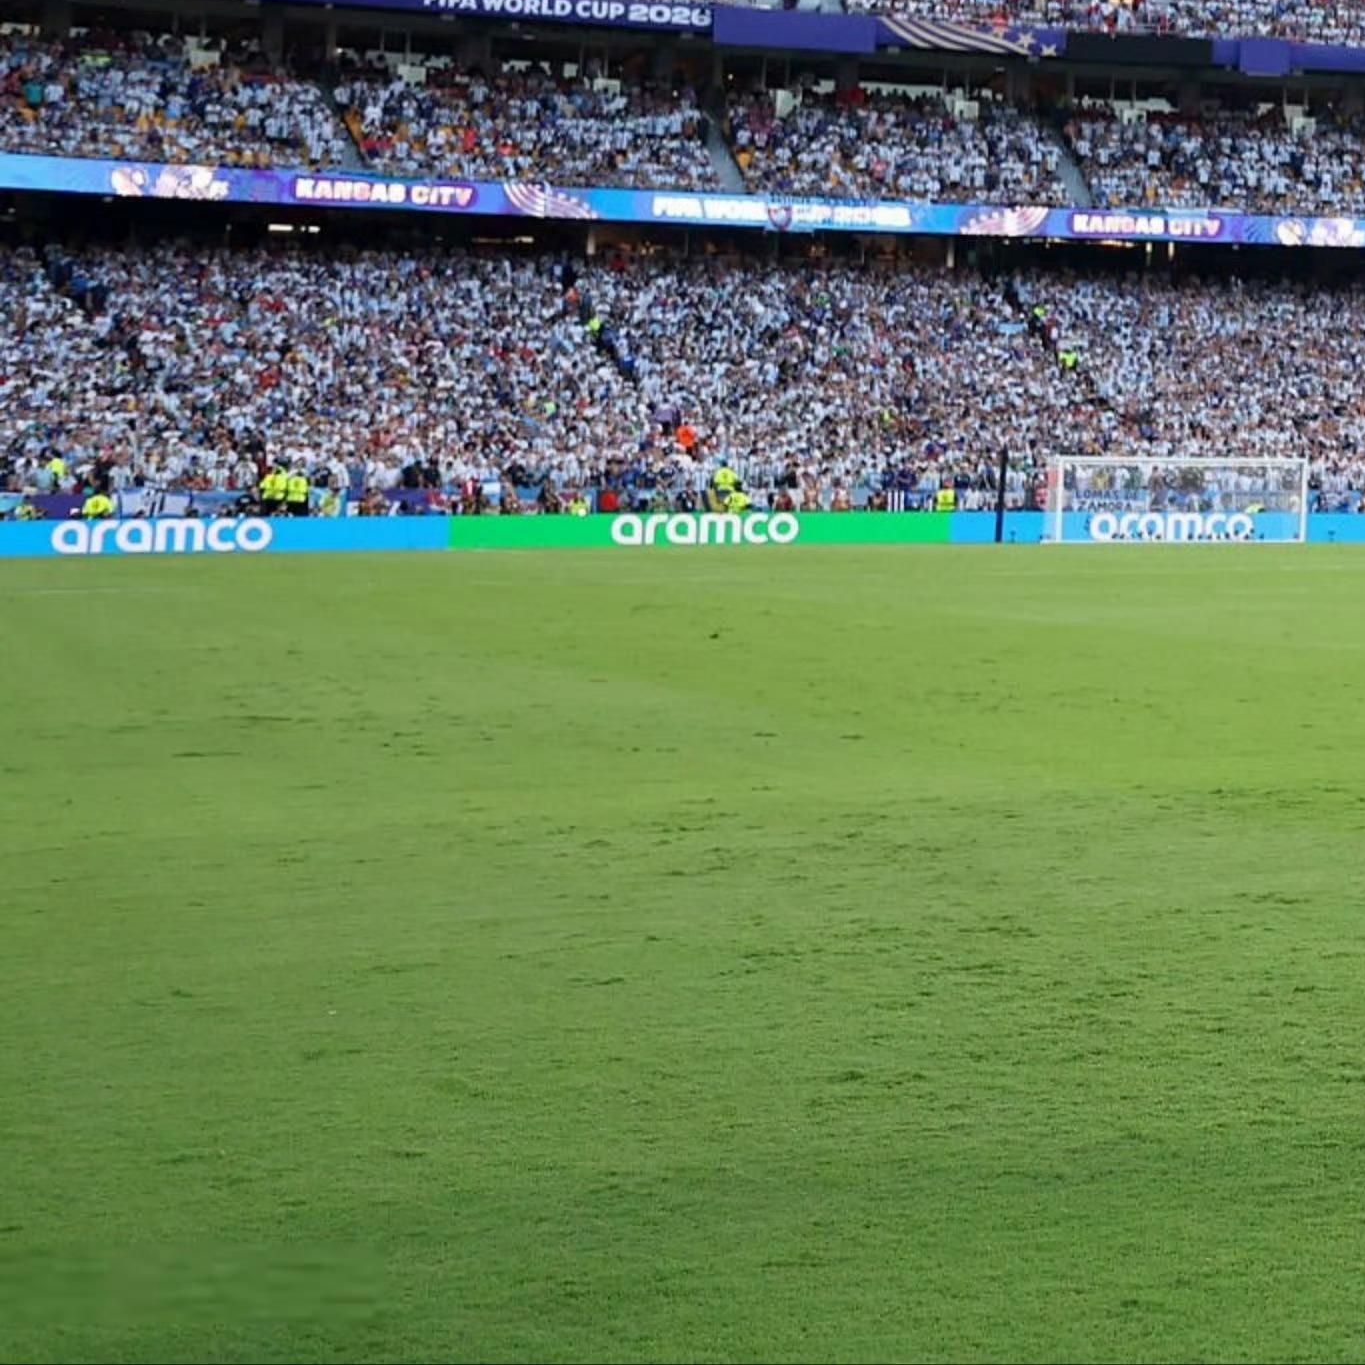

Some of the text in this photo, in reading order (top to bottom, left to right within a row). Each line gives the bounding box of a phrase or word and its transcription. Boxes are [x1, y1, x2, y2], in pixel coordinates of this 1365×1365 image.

[575, 0, 625, 19] CUP
[628, 4, 712, 26] 2026
[51, 517, 273, 554] aramco
[611, 512, 799, 545] aramco
[1090, 512, 1254, 541] aramco
